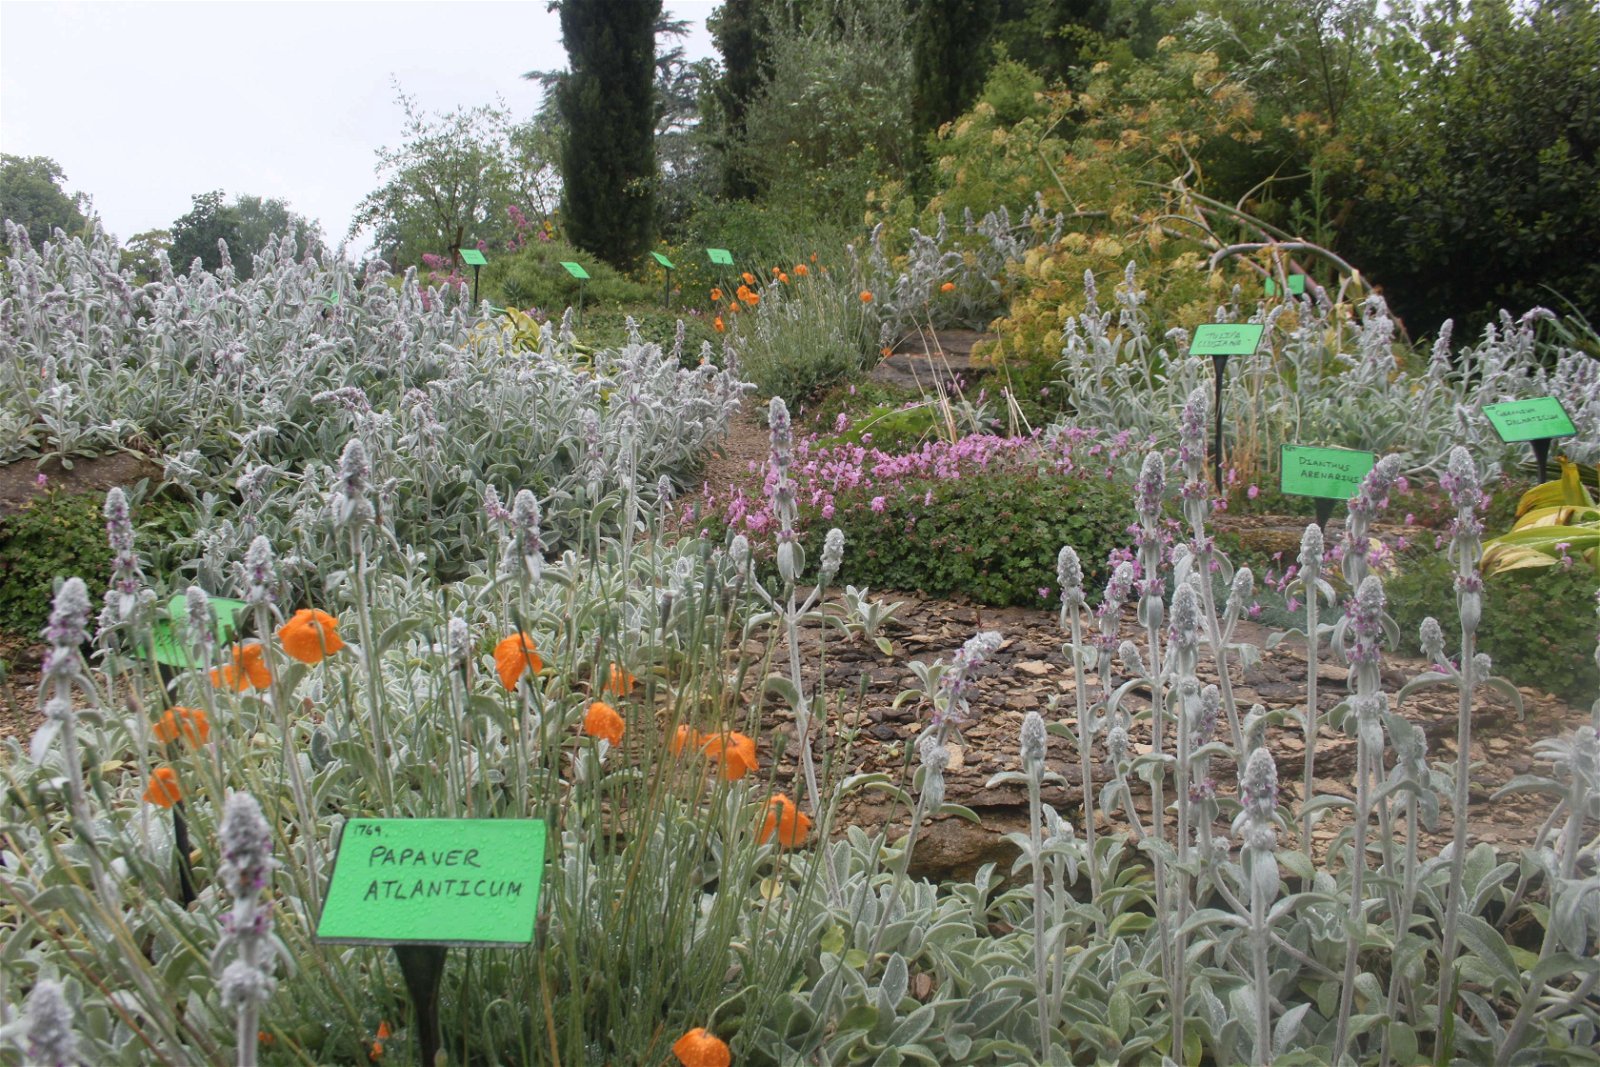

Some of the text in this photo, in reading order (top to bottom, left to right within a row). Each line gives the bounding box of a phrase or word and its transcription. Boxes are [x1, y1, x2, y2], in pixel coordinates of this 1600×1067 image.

[1298, 456, 1352, 472] DIANTHUS
[1300, 469, 1360, 484] ARENARIUS
[369, 845, 481, 868] PAPAVER
[363, 879, 523, 901] ATLANTICUM
